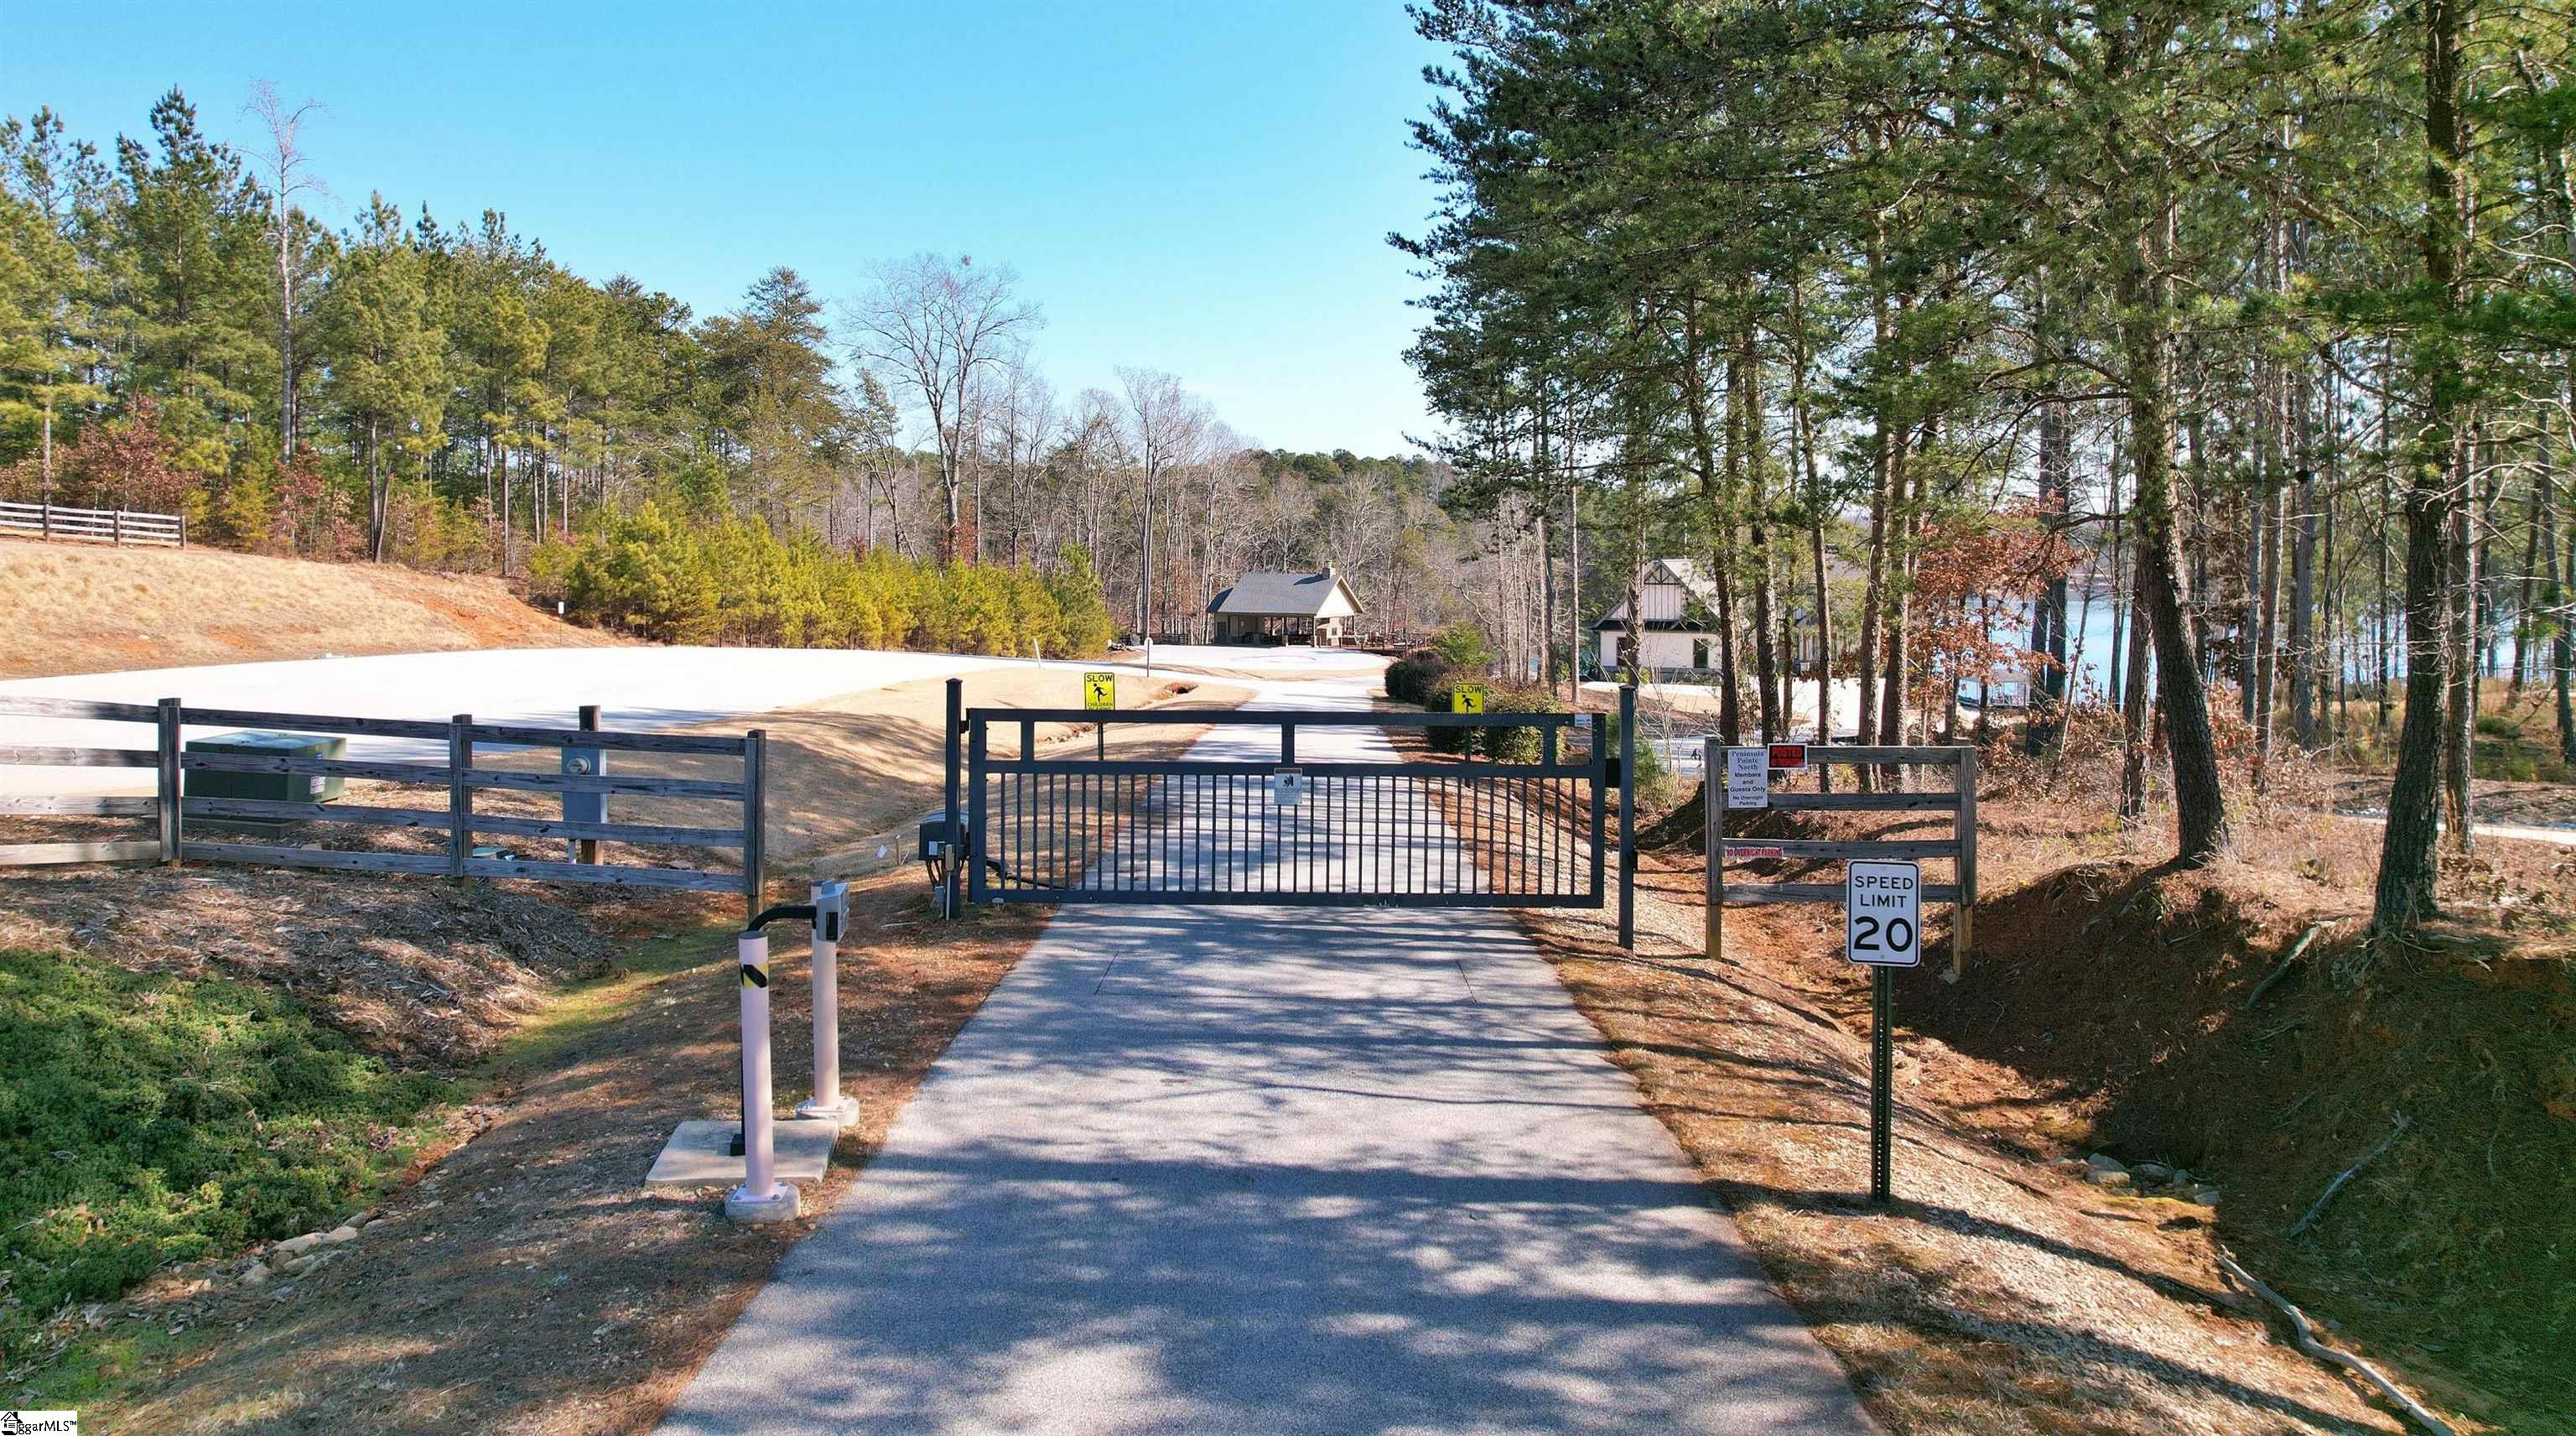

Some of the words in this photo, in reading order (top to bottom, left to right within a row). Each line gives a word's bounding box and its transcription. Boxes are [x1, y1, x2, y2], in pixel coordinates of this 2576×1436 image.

[1771, 747, 1803, 757] POSTED
[1854, 876, 1914, 890] SPEED
[1860, 894, 1907, 908] LIMIT
[1853, 916, 1913, 952] 20
